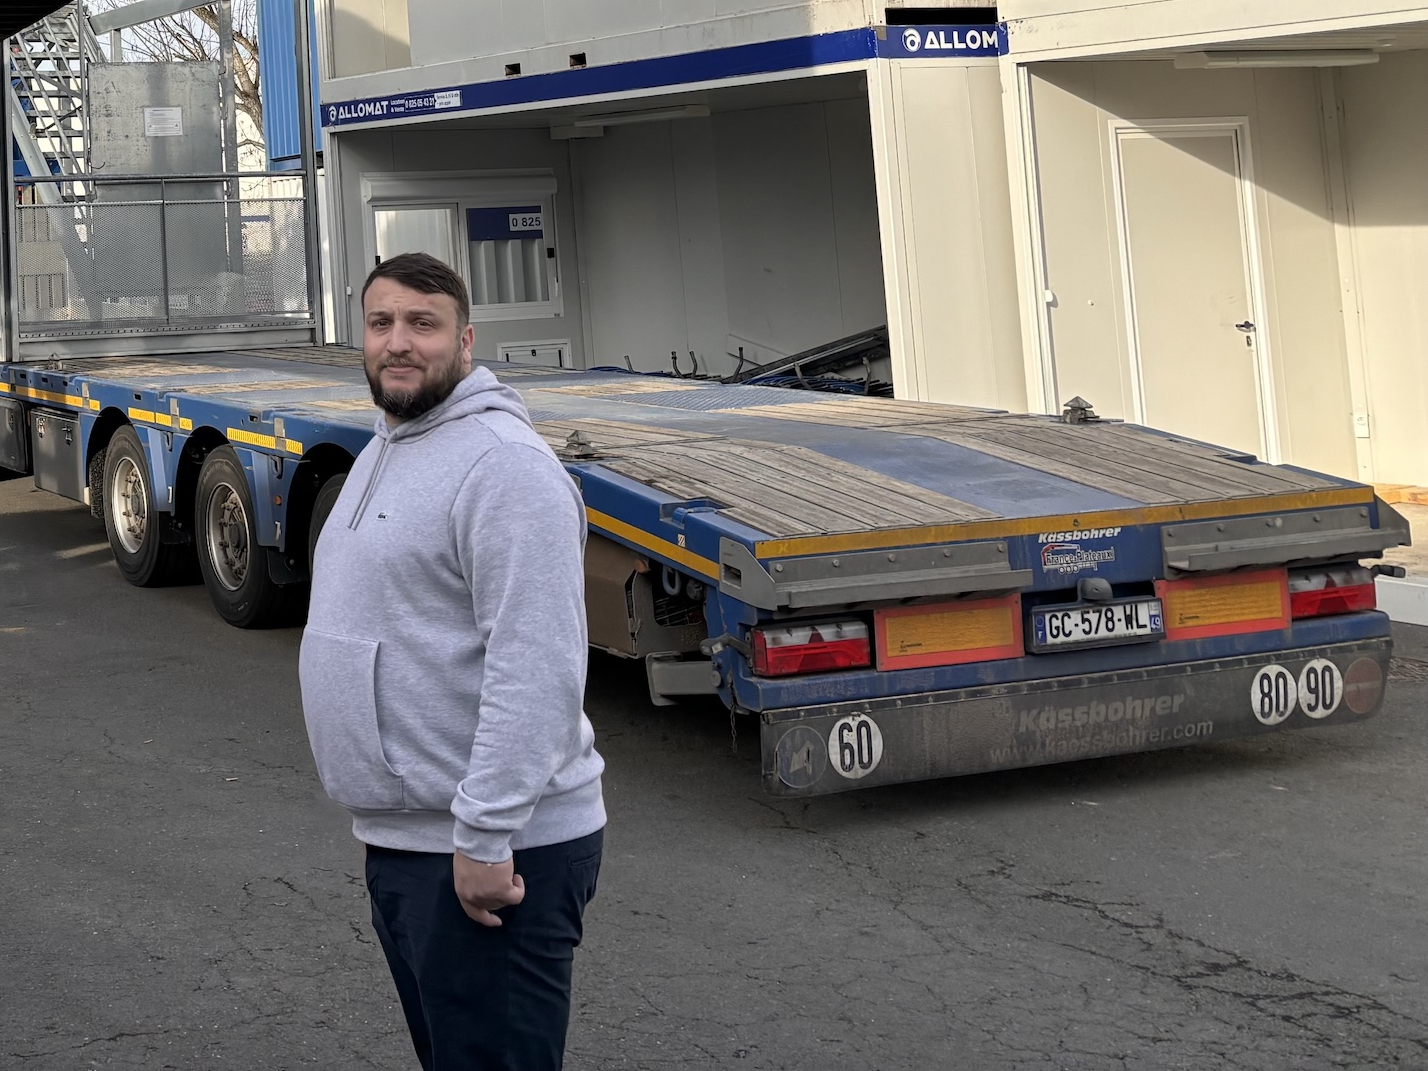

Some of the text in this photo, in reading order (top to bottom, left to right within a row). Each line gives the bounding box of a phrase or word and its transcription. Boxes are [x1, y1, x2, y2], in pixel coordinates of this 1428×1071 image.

[338, 101, 389, 119] ALLOMAT
[511, 216, 541, 228] 0 825
[1037, 630, 1043, 640] F
[1048, 603, 1148, 640] GC-578-WL
[1150, 616, 1161, 629] 49
[1259, 671, 1289, 719] 80
[1306, 665, 1334, 713] 90
[838, 720, 873, 772] 60
